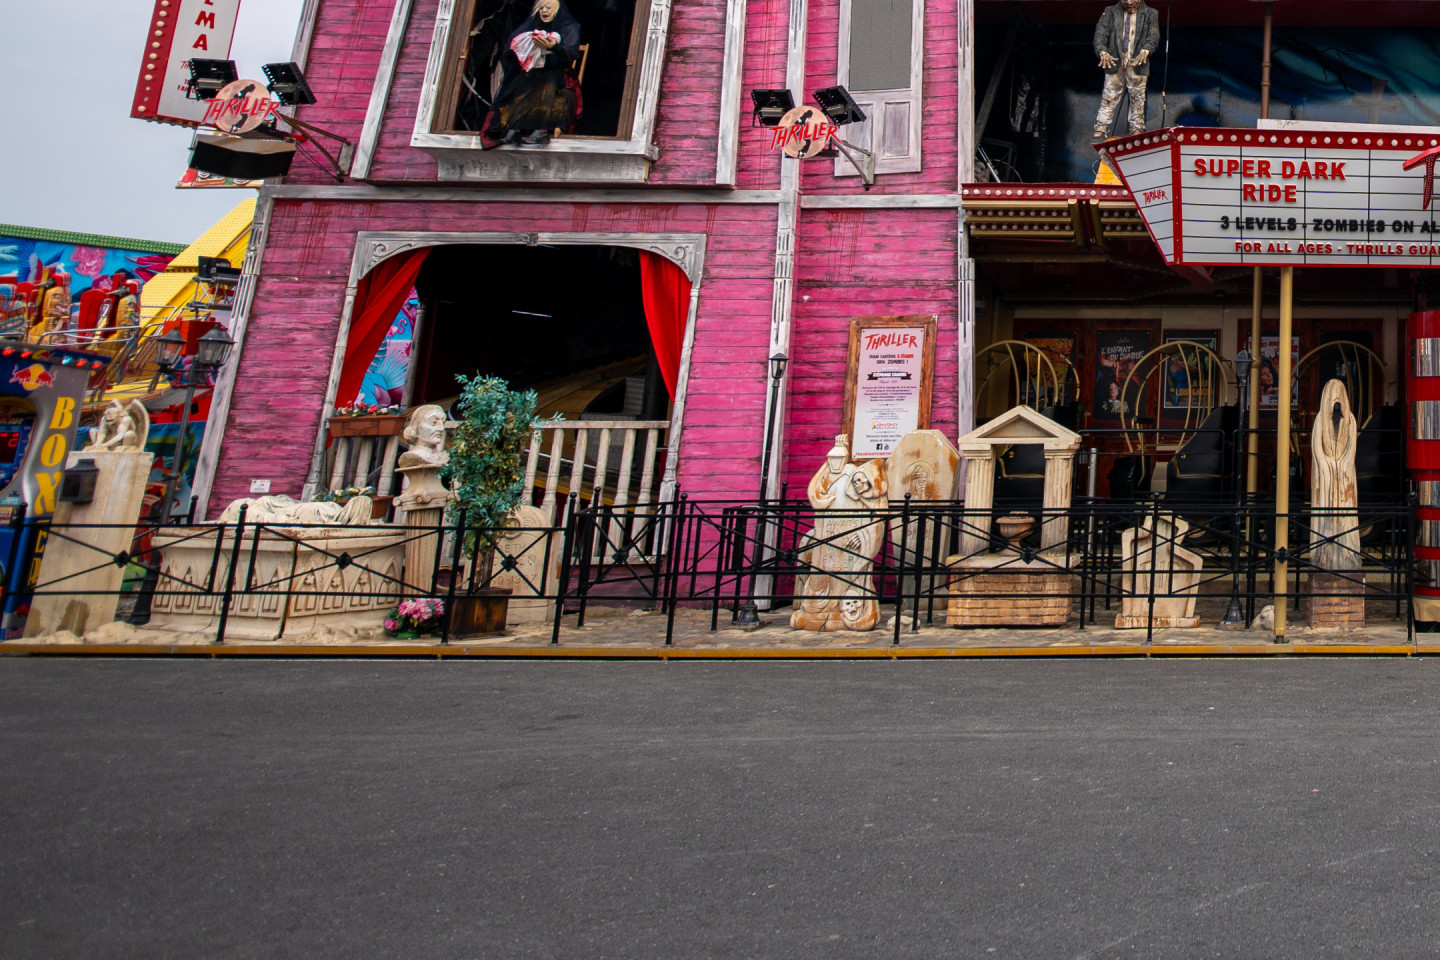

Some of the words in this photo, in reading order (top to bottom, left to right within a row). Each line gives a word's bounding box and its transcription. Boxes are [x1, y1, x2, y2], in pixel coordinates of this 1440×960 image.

[201, 95, 284, 125] THRILLER
[770, 122, 843, 151] THRILLER
[1194, 158, 1272, 178] SUPER
[1281, 161, 1347, 181] DARK
[1142, 189, 1168, 205] THRILLER
[1242, 183, 1297, 203] RIDE
[1220, 216, 1230, 230] 3
[1235, 216, 1297, 231] LEVELS
[1313, 218, 1386, 233] ZOMBIES
[1392, 219, 1414, 233] ON
[1235, 241, 1262, 253] FOR
[1267, 242, 1293, 253] ALL
[1297, 242, 1333, 254] AGES
[1346, 243, 1403, 255] THRILLS
[865, 333, 918, 351] THRILLER
[1101, 346, 1134, 355] L'ENFANT
[1120, 351, 1144, 360] DIABLE
[826, 520, 858, 528] AWAITS
